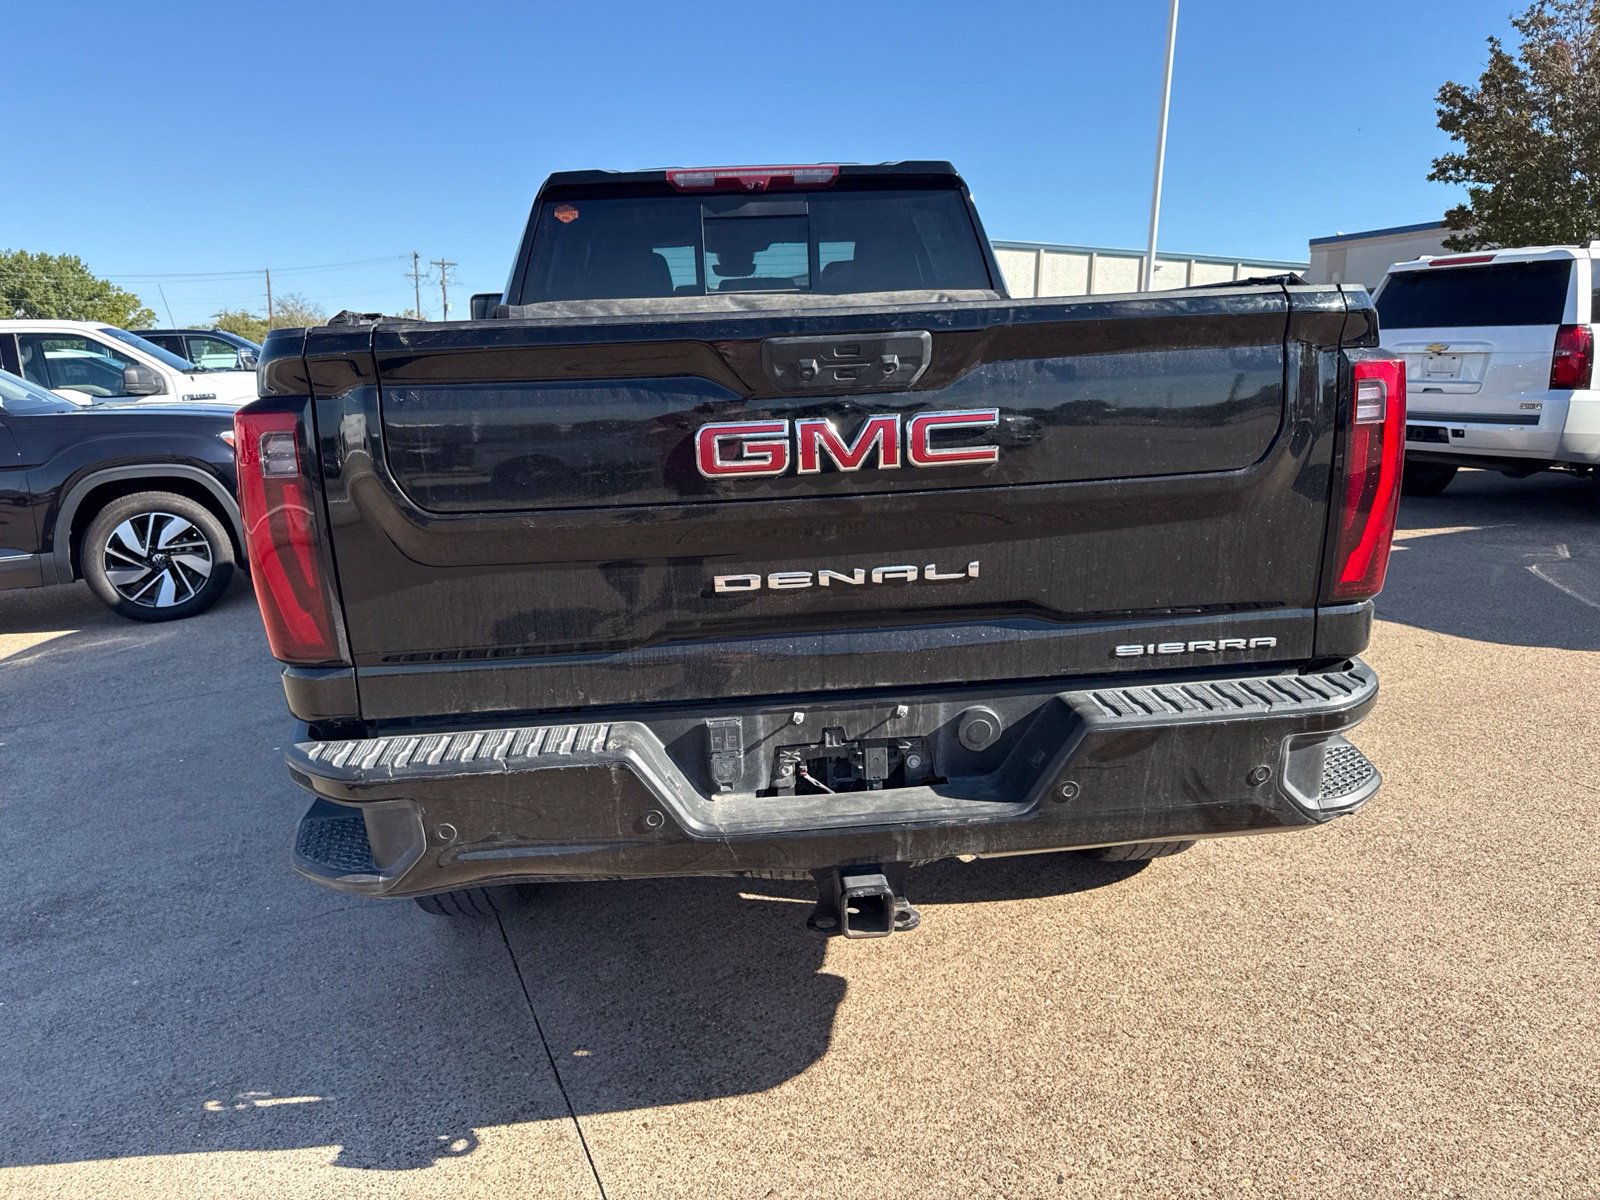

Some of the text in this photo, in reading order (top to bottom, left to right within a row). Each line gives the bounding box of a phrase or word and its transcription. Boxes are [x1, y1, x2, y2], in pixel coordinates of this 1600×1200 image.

[695, 408, 999, 478] GMC
[713, 560, 979, 593] DENALI
[1115, 637, 1277, 656] SIERRA
